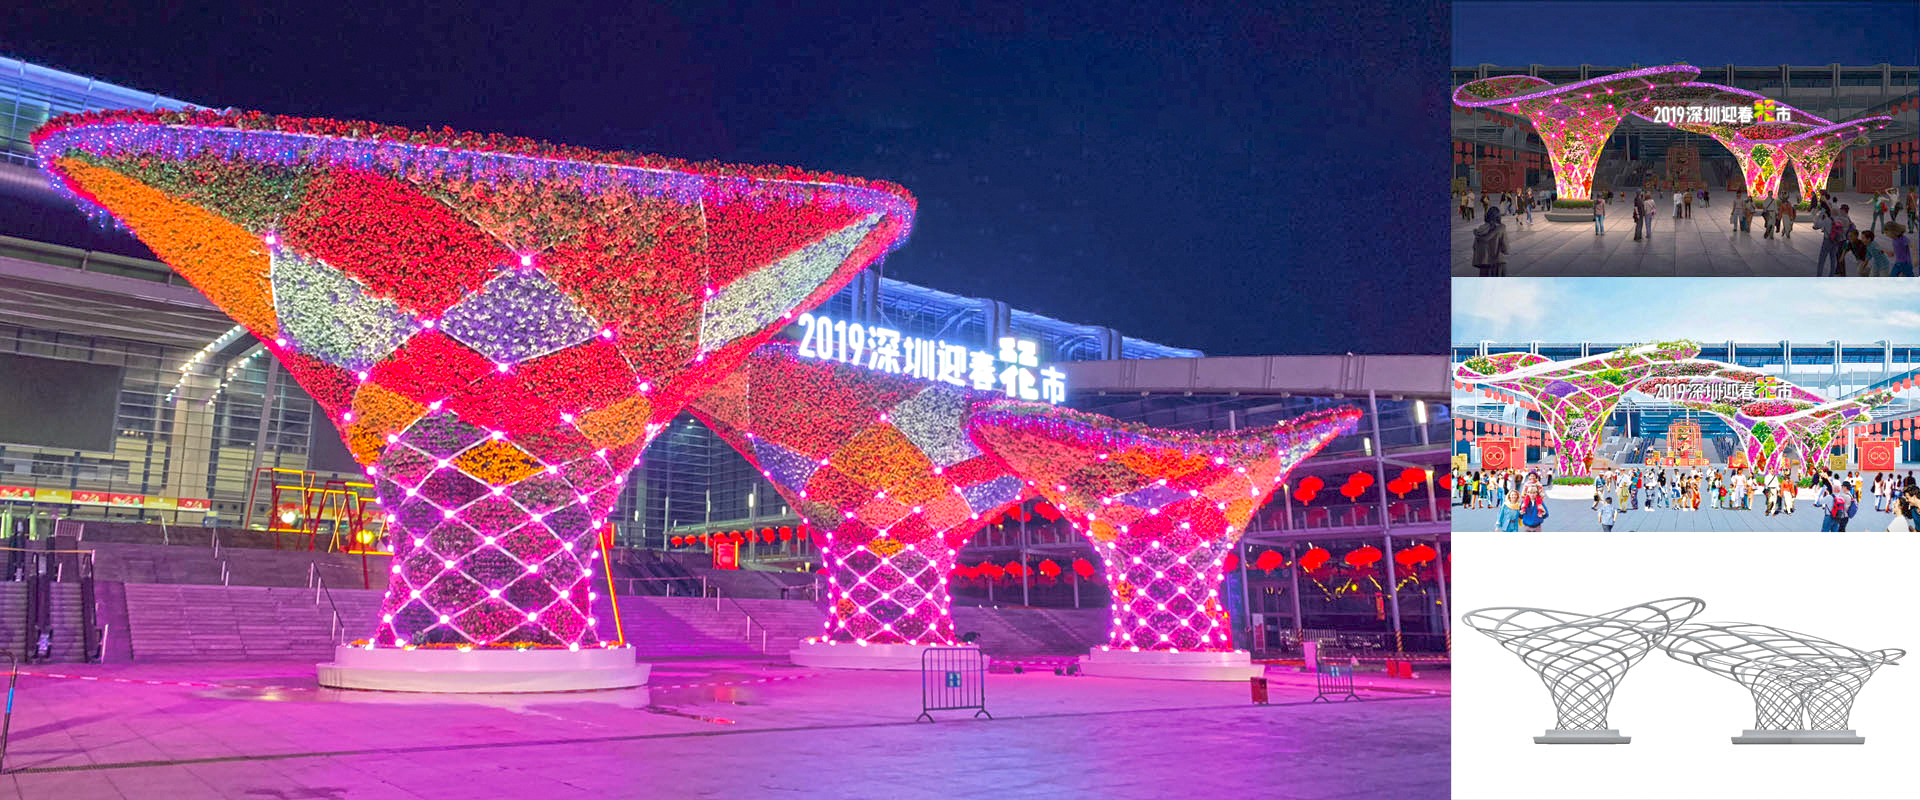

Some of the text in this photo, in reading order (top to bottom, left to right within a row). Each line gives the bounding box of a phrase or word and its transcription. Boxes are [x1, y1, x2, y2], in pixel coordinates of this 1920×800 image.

[1653, 100, 1791, 124] 2019深圳迎春花市
[798, 313, 1067, 405] 2019深圳迎春花市
[1654, 376, 1793, 400] 2019深圳迎春花市
